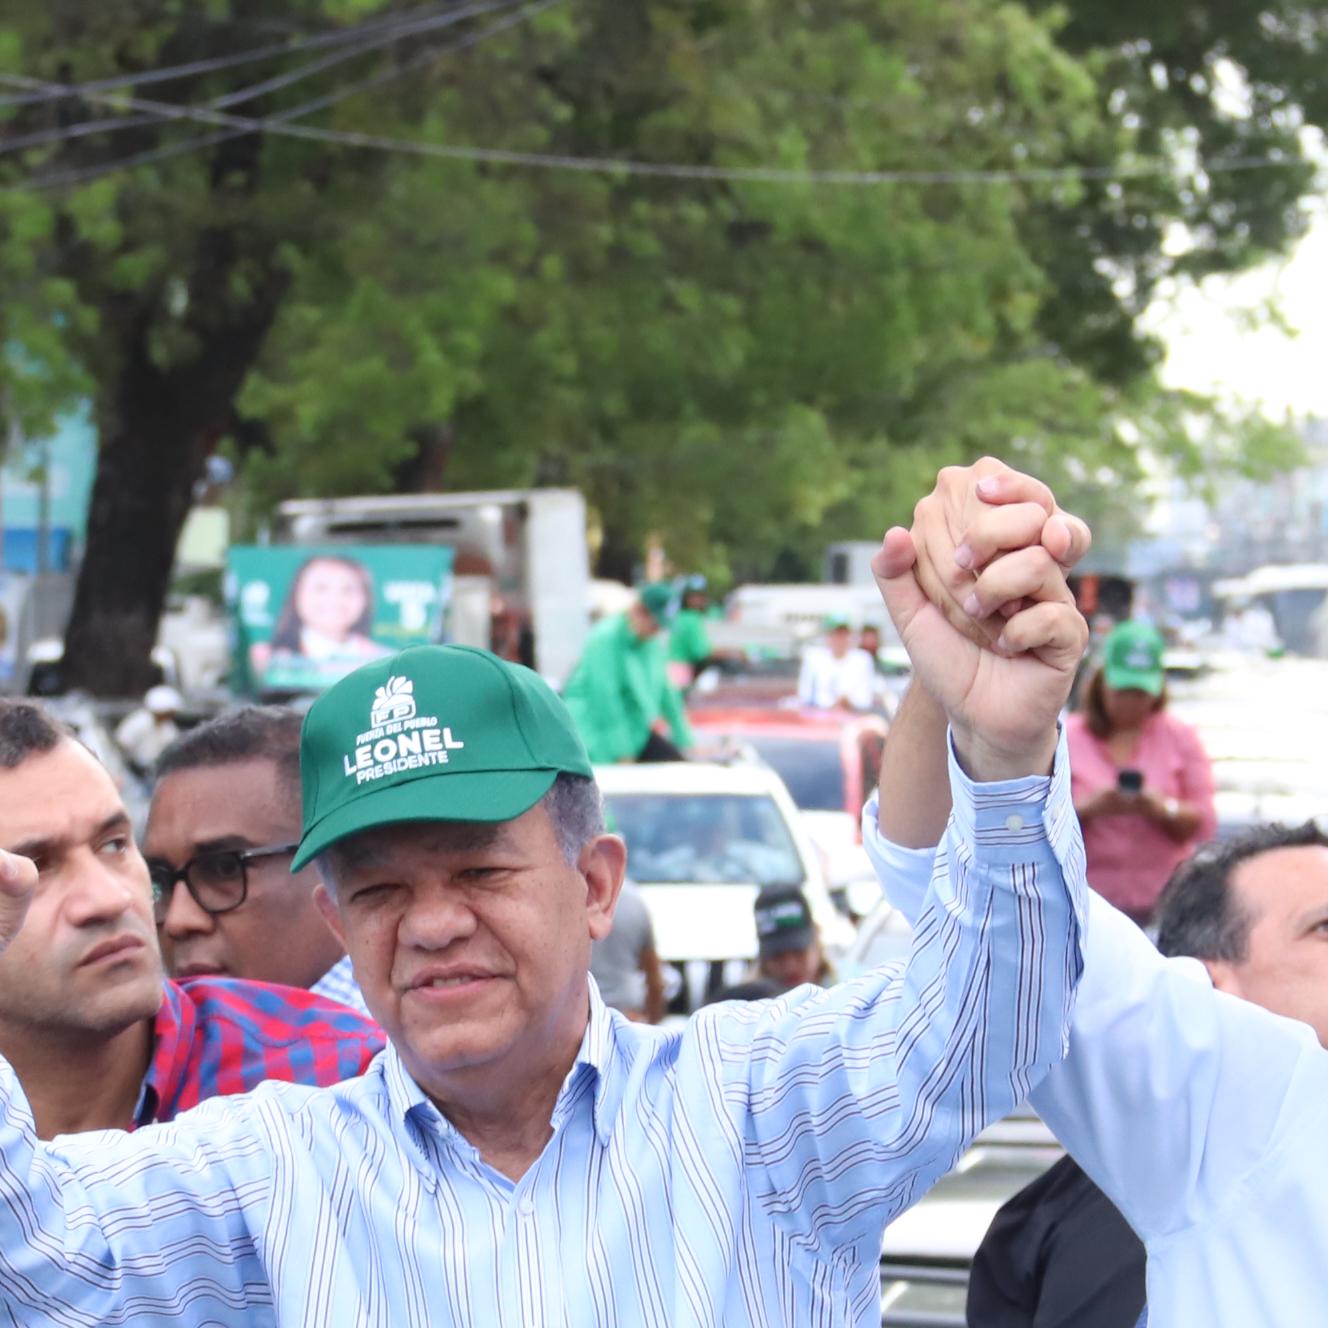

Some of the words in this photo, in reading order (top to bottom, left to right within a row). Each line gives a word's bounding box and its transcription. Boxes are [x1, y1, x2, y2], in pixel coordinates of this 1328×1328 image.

[386, 721, 403, 735] DEL
[343, 727, 464, 777] LEONEL
[356, 750, 449, 785] PRESIDENTE
